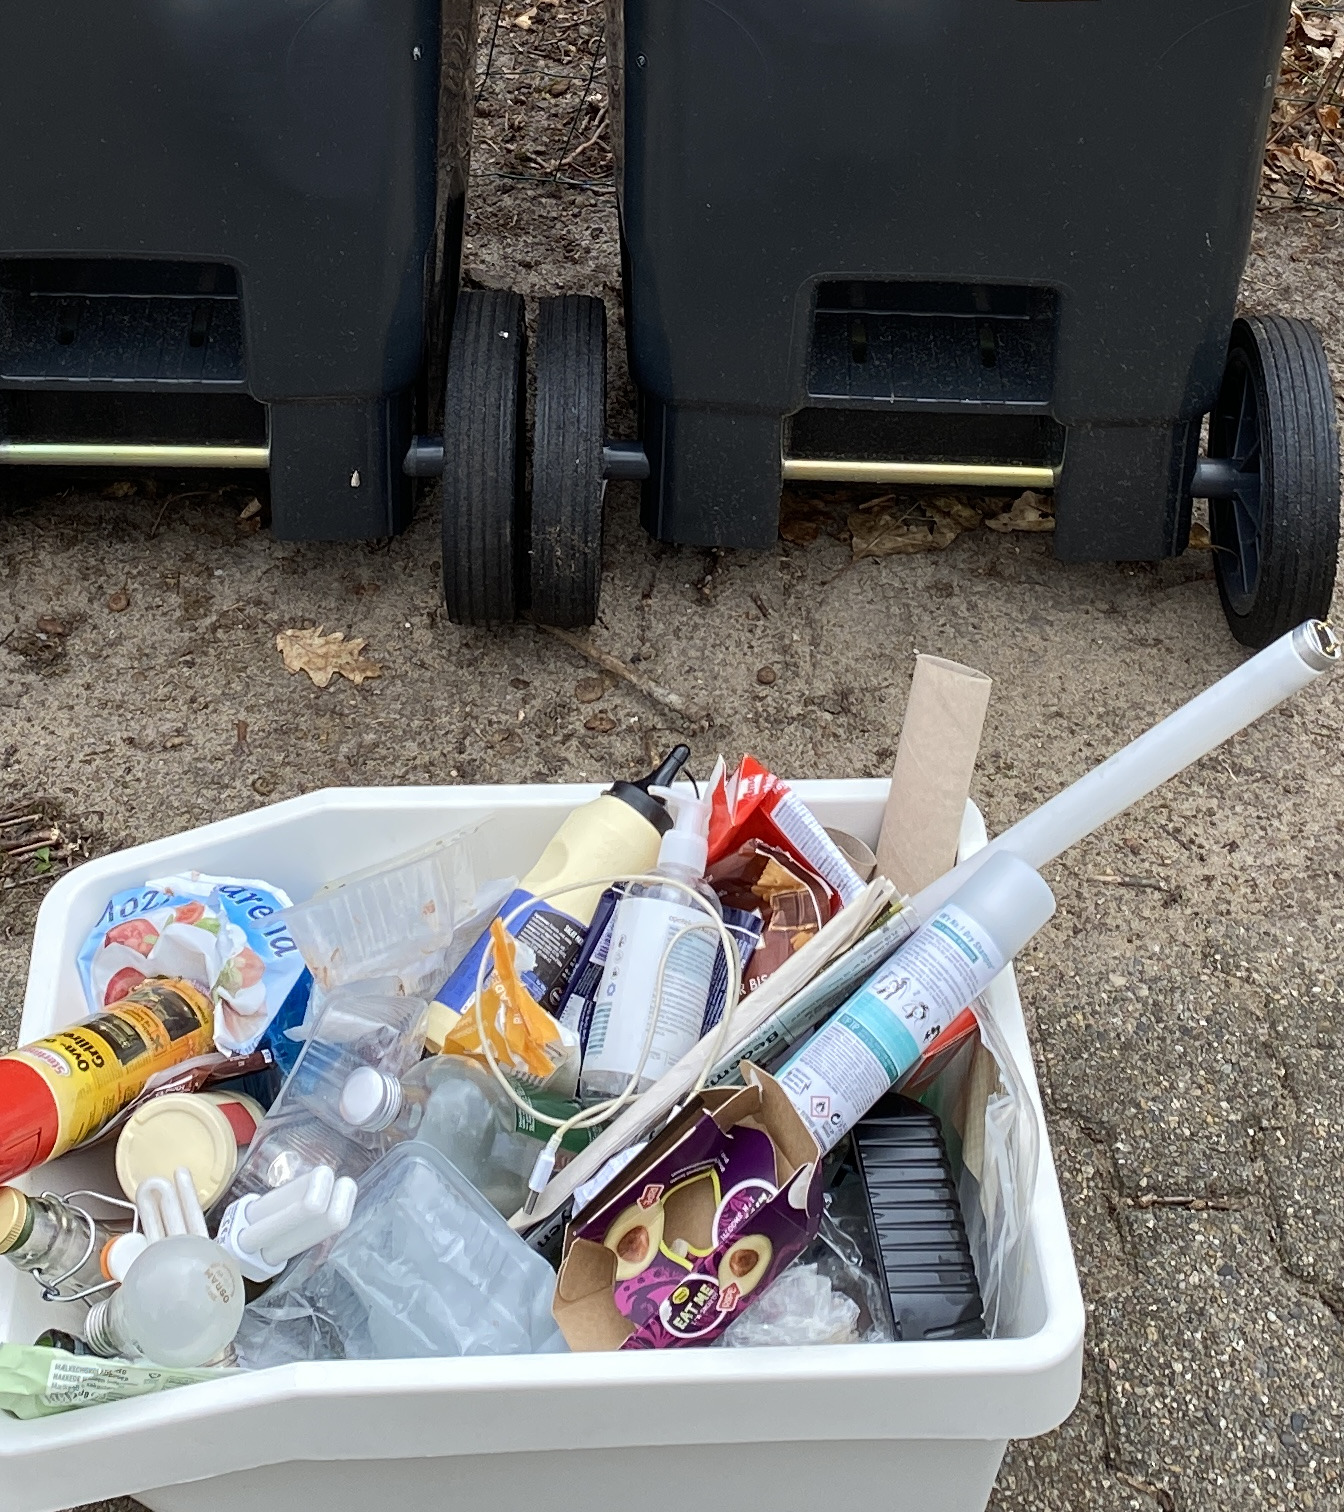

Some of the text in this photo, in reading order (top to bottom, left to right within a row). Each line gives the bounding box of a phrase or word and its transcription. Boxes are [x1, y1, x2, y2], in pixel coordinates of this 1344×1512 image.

[204, 1268, 230, 1304] OSRAM
[673, 1301, 699, 1330] EAT
[693, 1283, 715, 1307] ME
